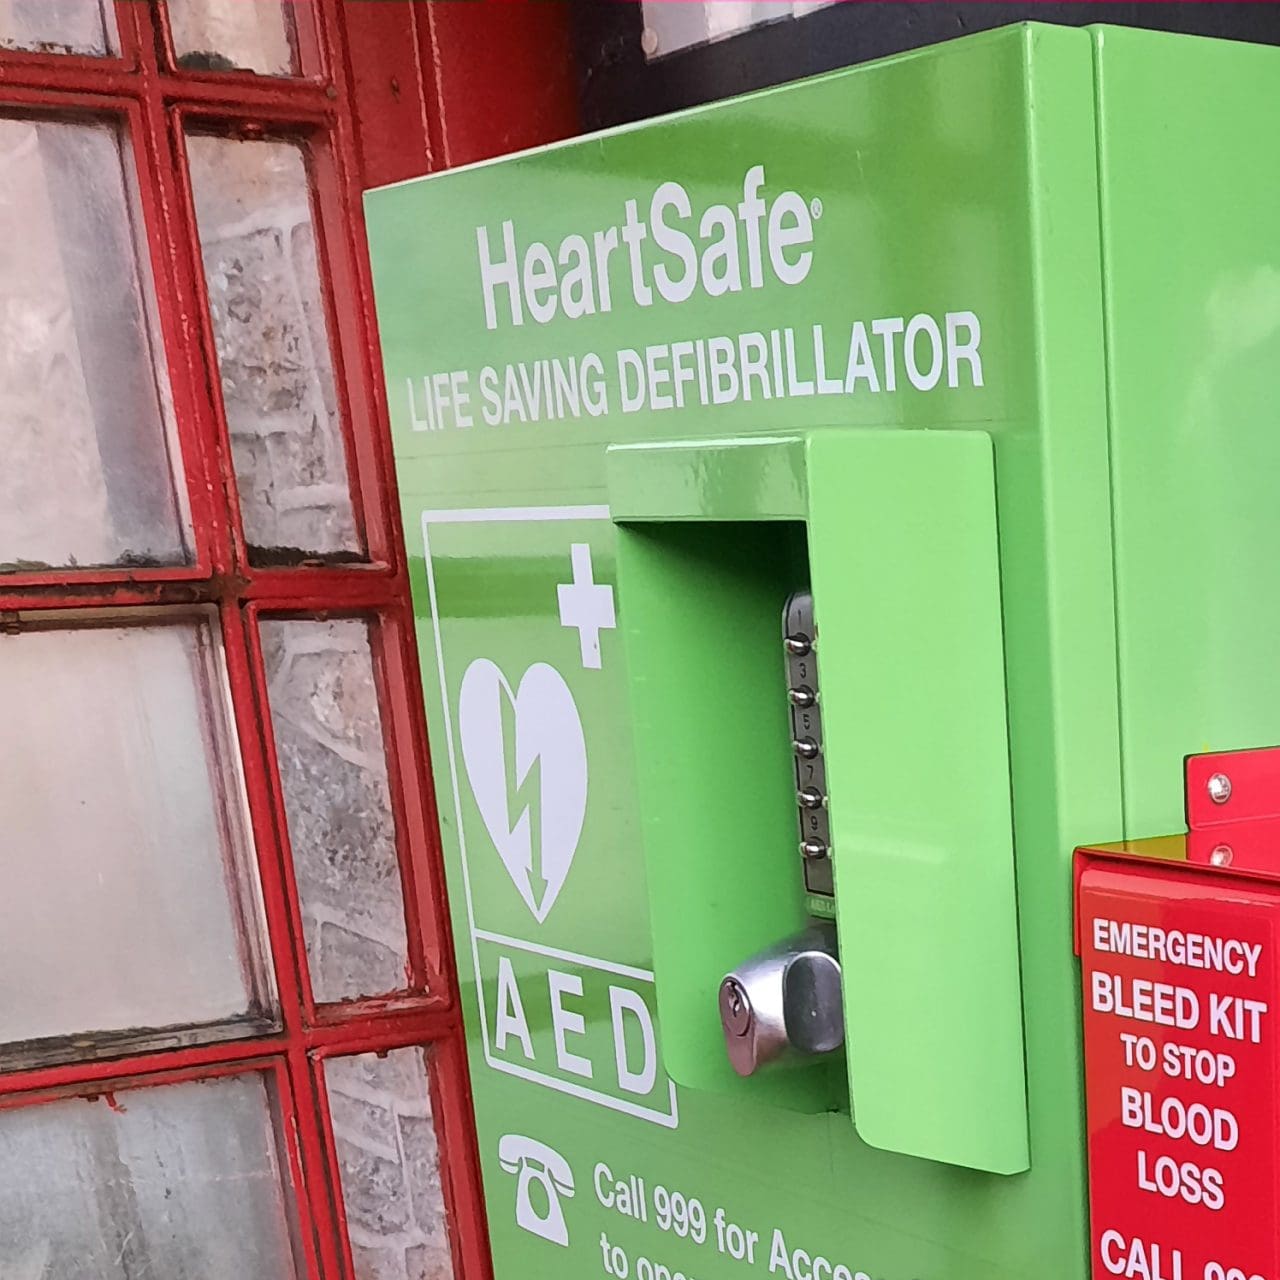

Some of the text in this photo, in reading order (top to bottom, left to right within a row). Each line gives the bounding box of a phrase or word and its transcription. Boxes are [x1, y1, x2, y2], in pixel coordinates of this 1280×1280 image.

[407, 311, 984, 432] LIFE SAVING DEFIBRILLATOR
[800, 662, 807, 677] 3
[803, 714, 810, 729] 5
[807, 765, 814, 779] 7
[811, 816, 818, 830] 9
[1092, 917, 1263, 978] EMERGENCY
[494, 956, 658, 1095] AED
[1091, 970, 1267, 1044] BLEED KIT
[1120, 1033, 1236, 1087] TO STOP
[1120, 1086, 1238, 1151] BLOOD
[1137, 1150, 1225, 1210] LOSS
[593, 1162, 647, 1223] Call
[654, 1186, 706, 1244] 999
[714, 1209, 758, 1263] for
[600, 1231, 629, 1279] to
